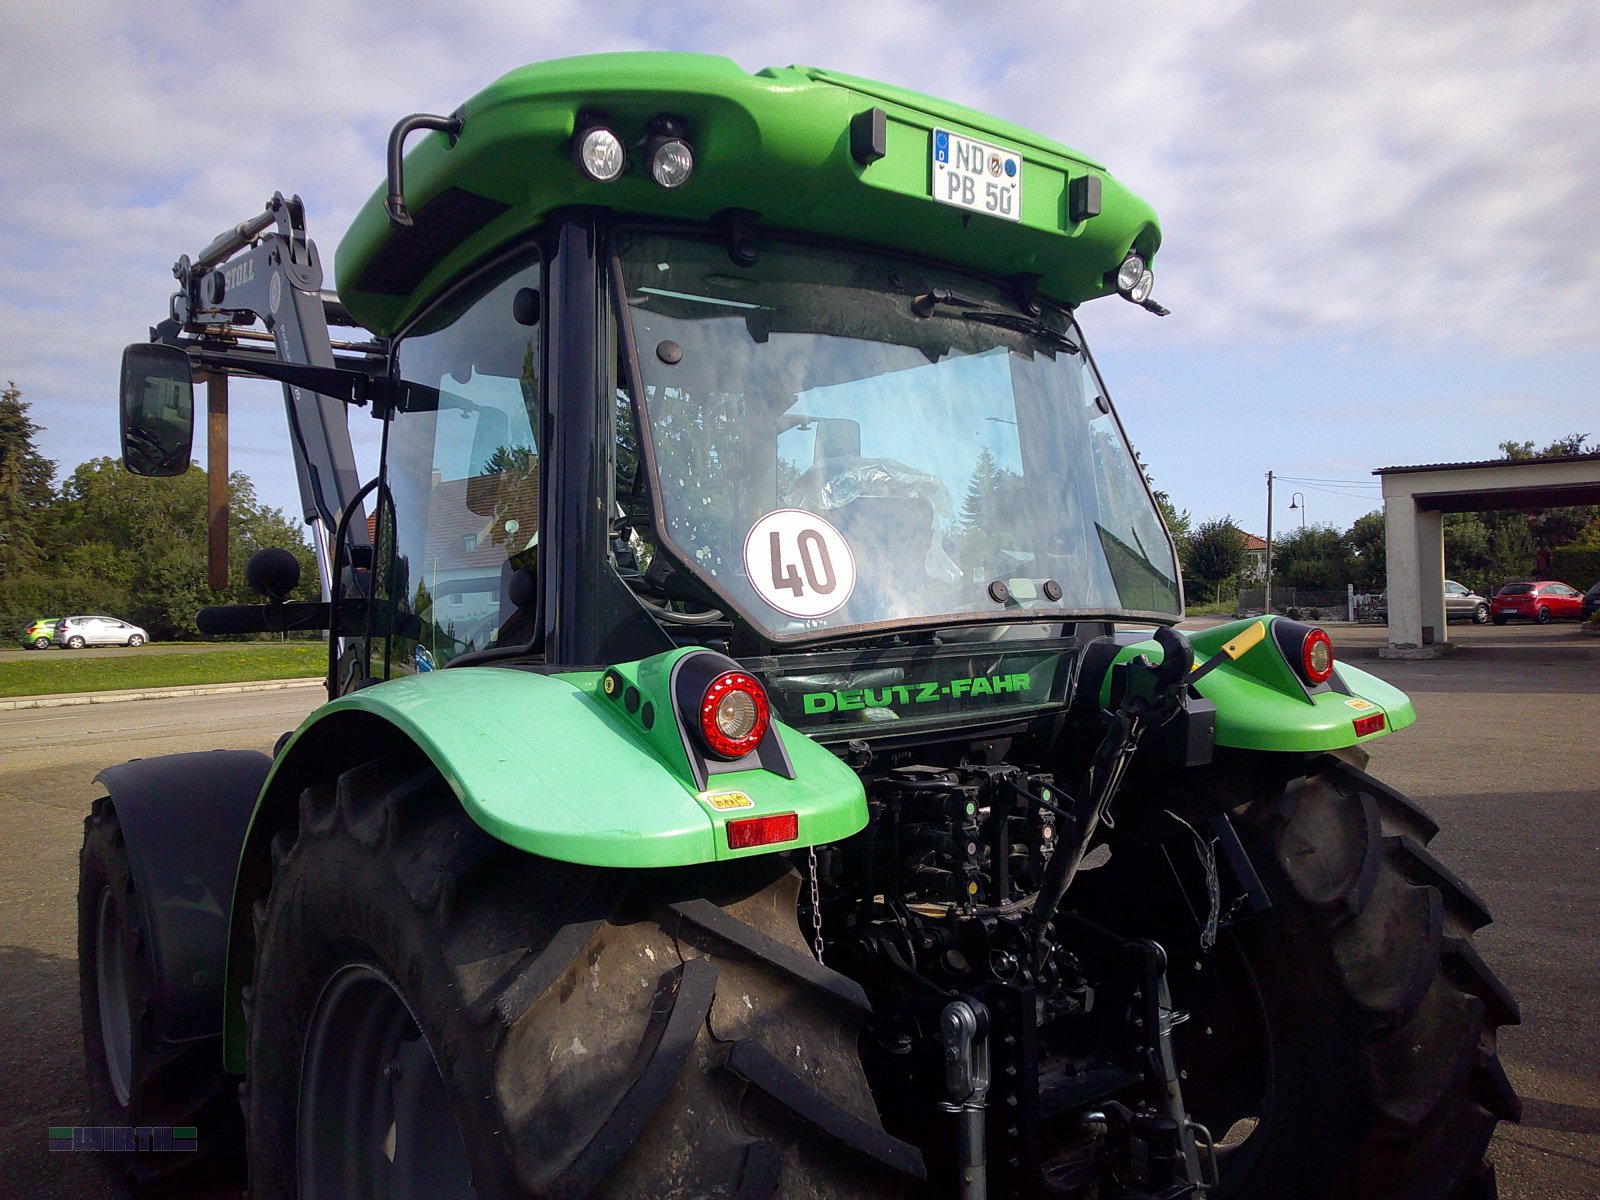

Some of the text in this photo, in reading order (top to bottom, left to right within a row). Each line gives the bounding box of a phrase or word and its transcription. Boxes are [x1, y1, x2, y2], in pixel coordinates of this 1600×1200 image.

[939, 150, 945, 161] D
[956, 140, 984, 175] ND
[947, 170, 1012, 215] PB 50
[225, 259, 255, 292] STOLL
[769, 529, 837, 597] 40
[802, 673, 1031, 715] DEUTZ-FAHR
